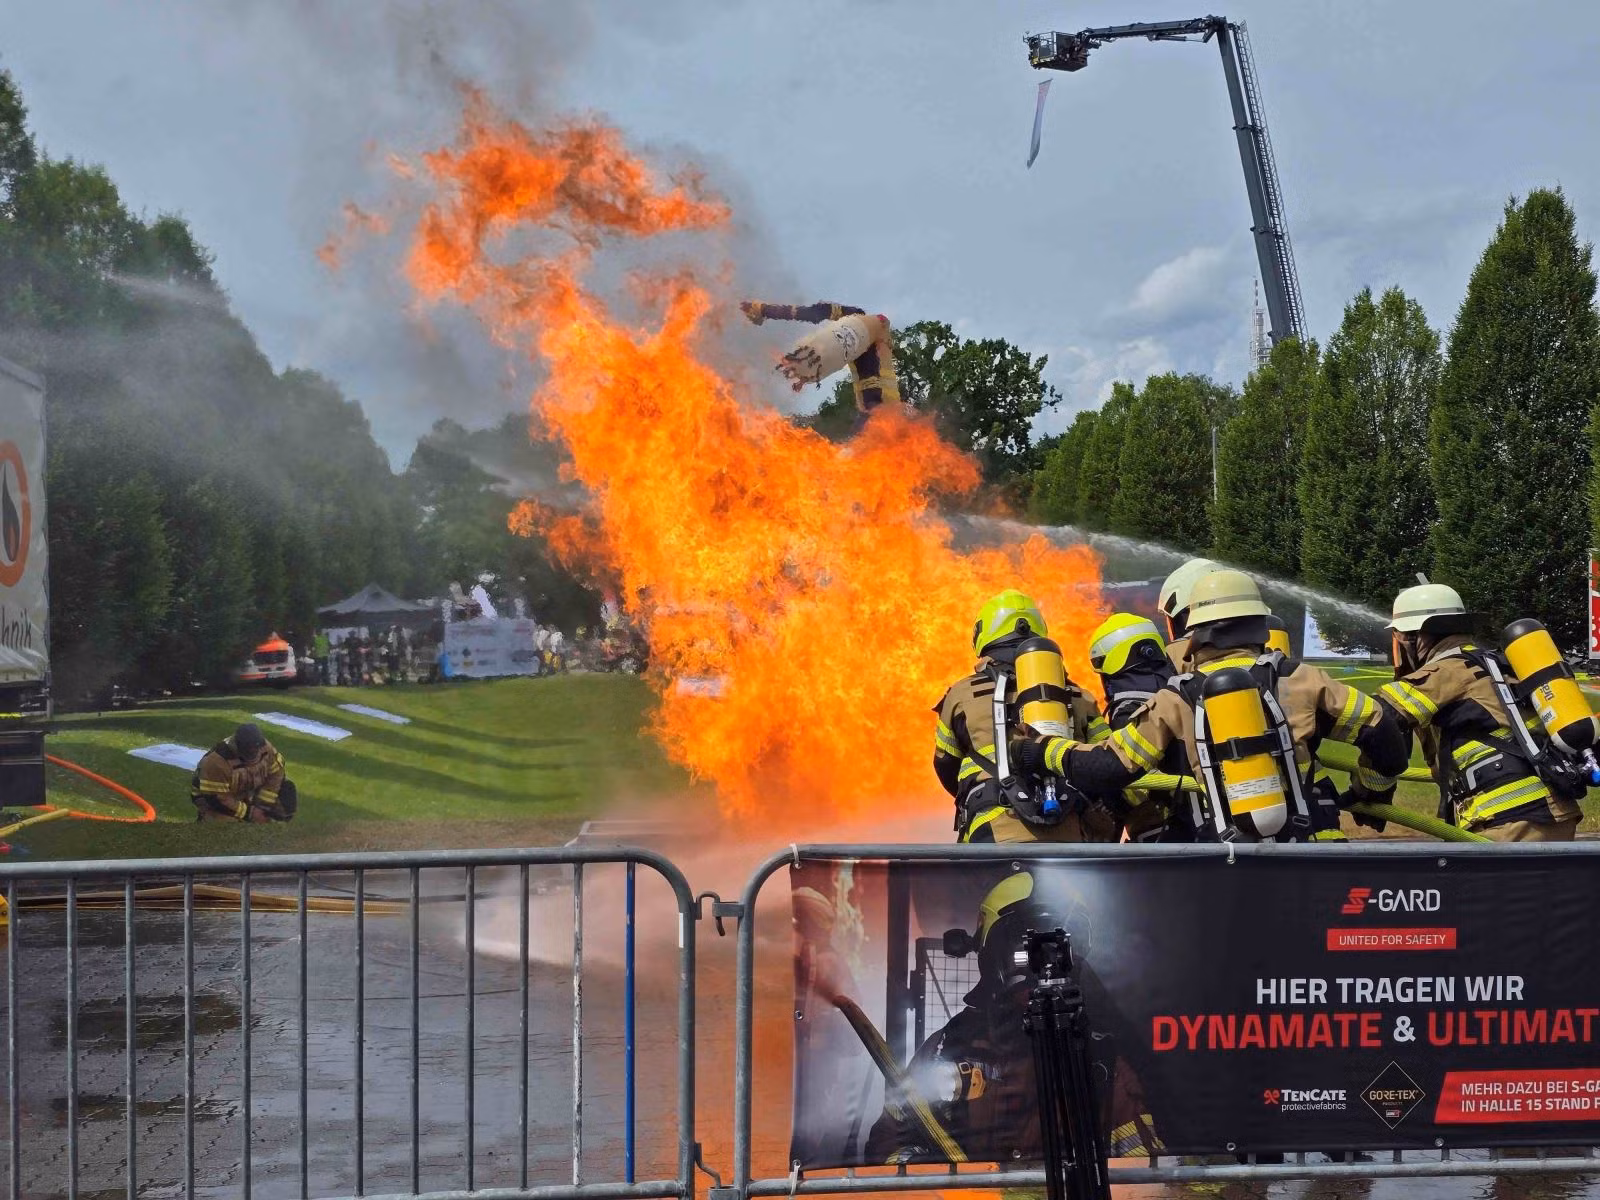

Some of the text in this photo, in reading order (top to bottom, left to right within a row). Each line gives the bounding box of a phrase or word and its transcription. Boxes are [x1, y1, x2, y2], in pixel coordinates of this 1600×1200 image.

[1341, 887, 1441, 914] S-GARD
[1339, 934, 1446, 946] UNITED FOR SAFETY
[1256, 975, 1525, 1005] HIER TRAGEN WIR
[1151, 1012, 1383, 1051] DYNAMATE
[1393, 1015, 1416, 1043] &
[1461, 1083, 1503, 1095] MEHR
[1506, 1081, 1543, 1095] DAZU
[1546, 1081, 1568, 1093] BEI
[1281, 1102, 1347, 1112] protectivefabrics
[1461, 1099, 1475, 1112] IN
[1479, 1099, 1522, 1112] HALLE
[1526, 1098, 1542, 1111] 15
[1545, 1097, 1590, 1110] STAND
